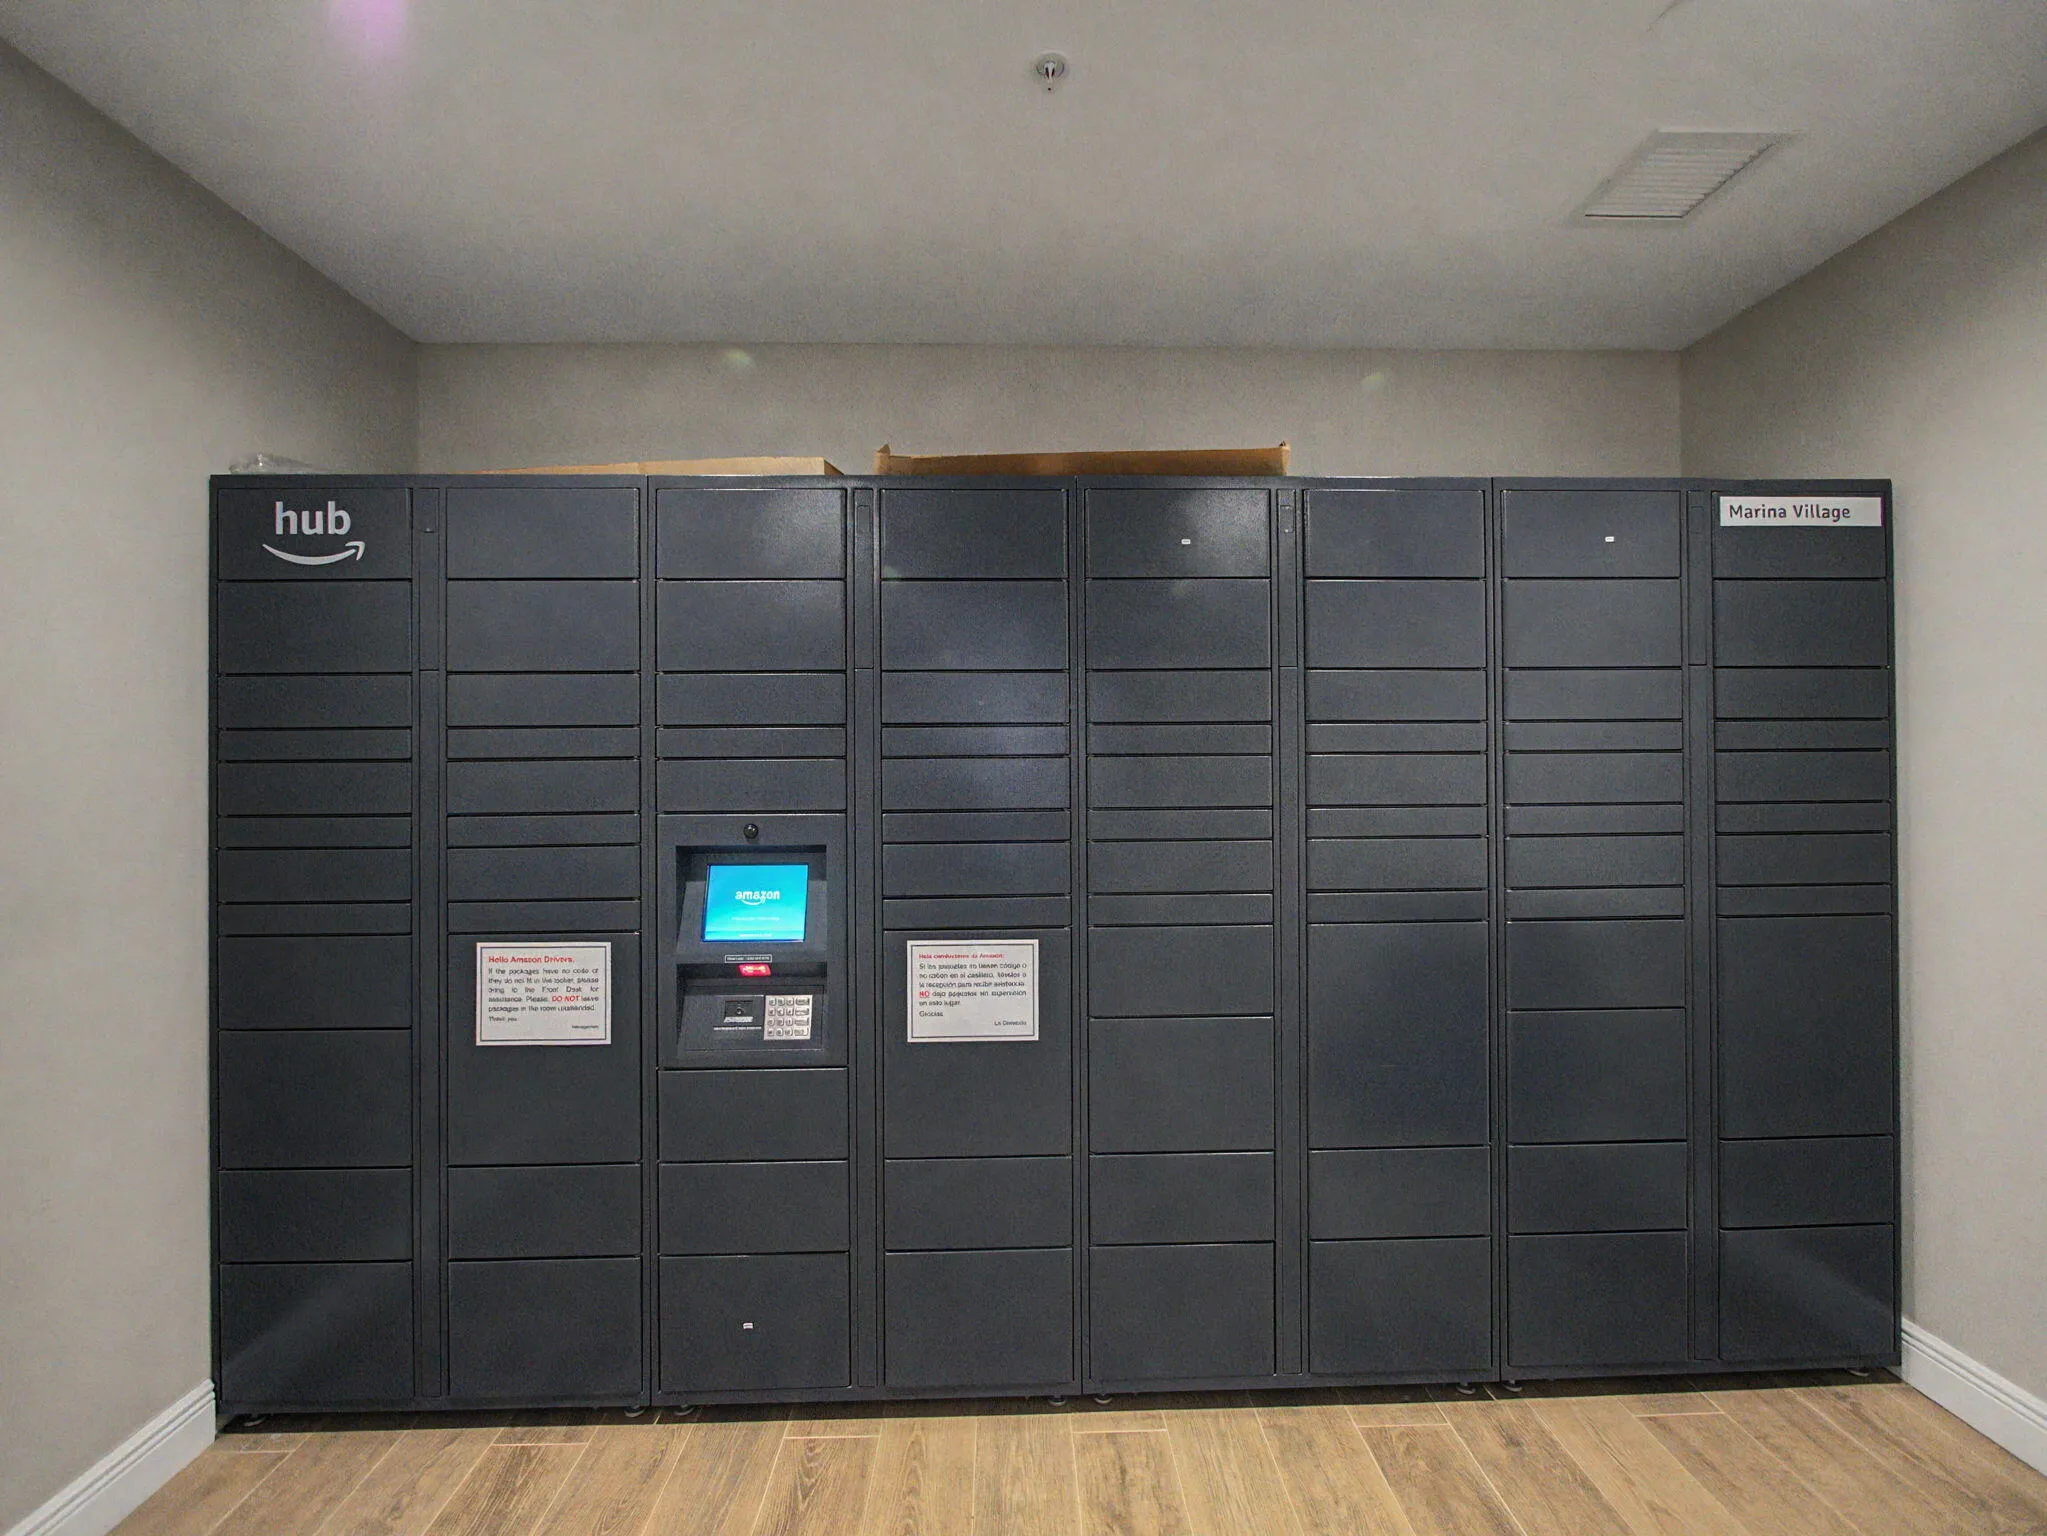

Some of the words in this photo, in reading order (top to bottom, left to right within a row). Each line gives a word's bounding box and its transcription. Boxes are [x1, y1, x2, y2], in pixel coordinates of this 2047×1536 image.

[275, 501, 351, 535] hub
[1729, 504, 1787, 518] Marina
[1792, 504, 1851, 522] Village
[735, 890, 780, 901] amazon
[489, 977, 502, 985] they
